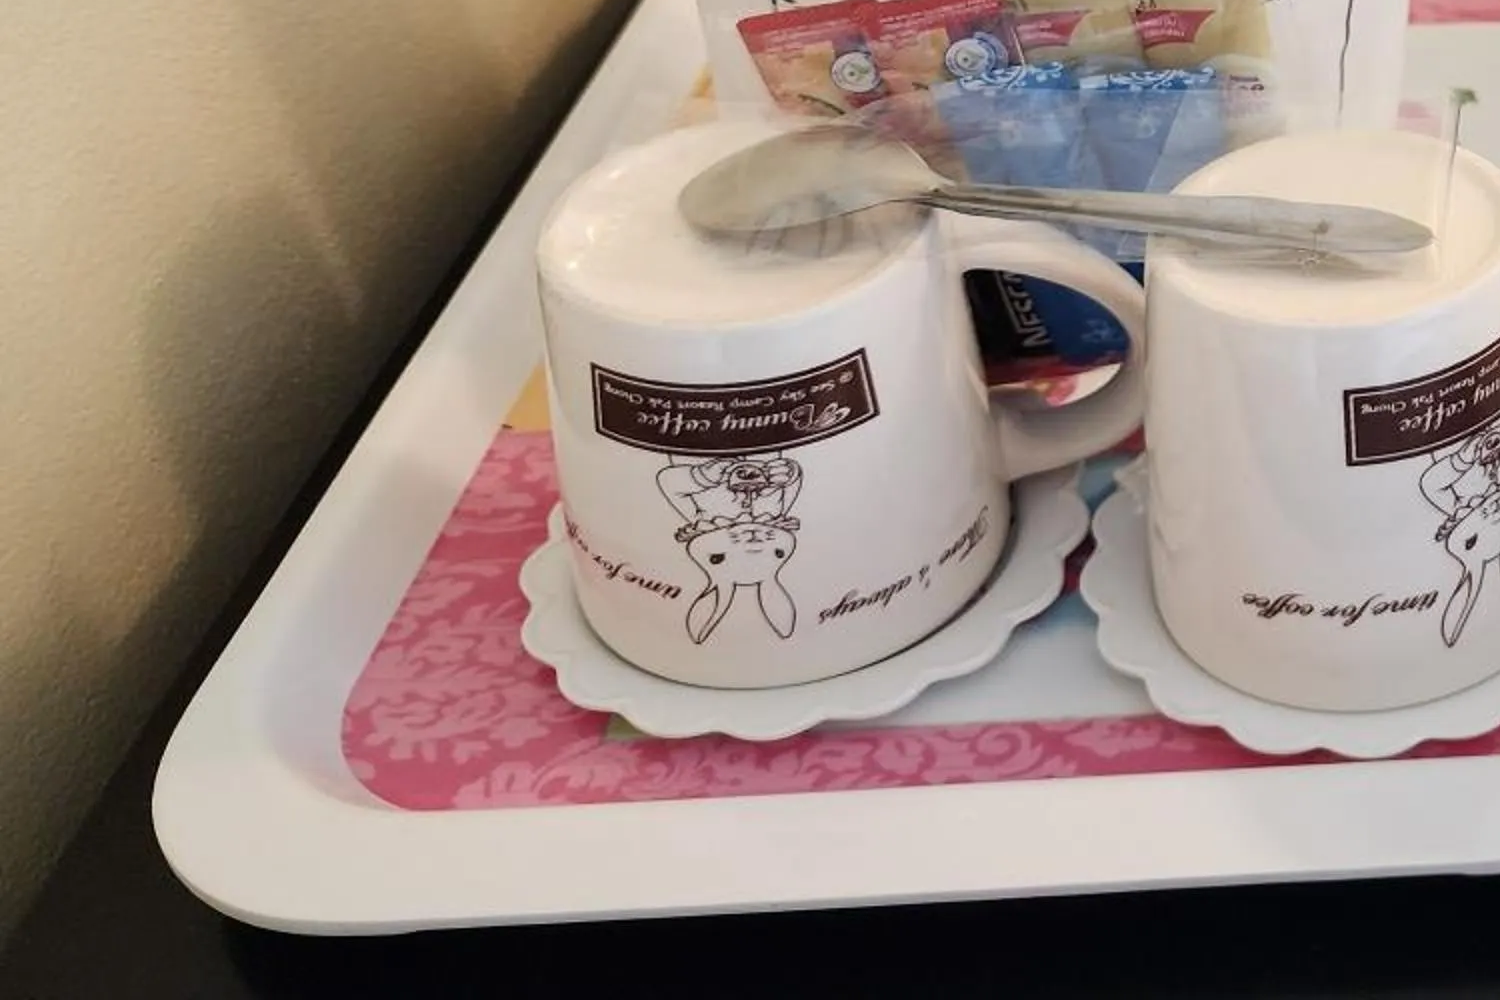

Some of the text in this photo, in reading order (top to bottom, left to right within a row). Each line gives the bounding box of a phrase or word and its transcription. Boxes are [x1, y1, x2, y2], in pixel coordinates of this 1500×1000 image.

[649, 396, 672, 411] Pak
[676, 399, 726, 413] Resort
[730, 395, 775, 410] Camp
[1398, 399, 1466, 434] coffee
[637, 402, 816, 438] Bunny coffee
[622, 571, 683, 600] time
[817, 573, 913, 625] always
[1241, 589, 1439, 628] time for coffee
